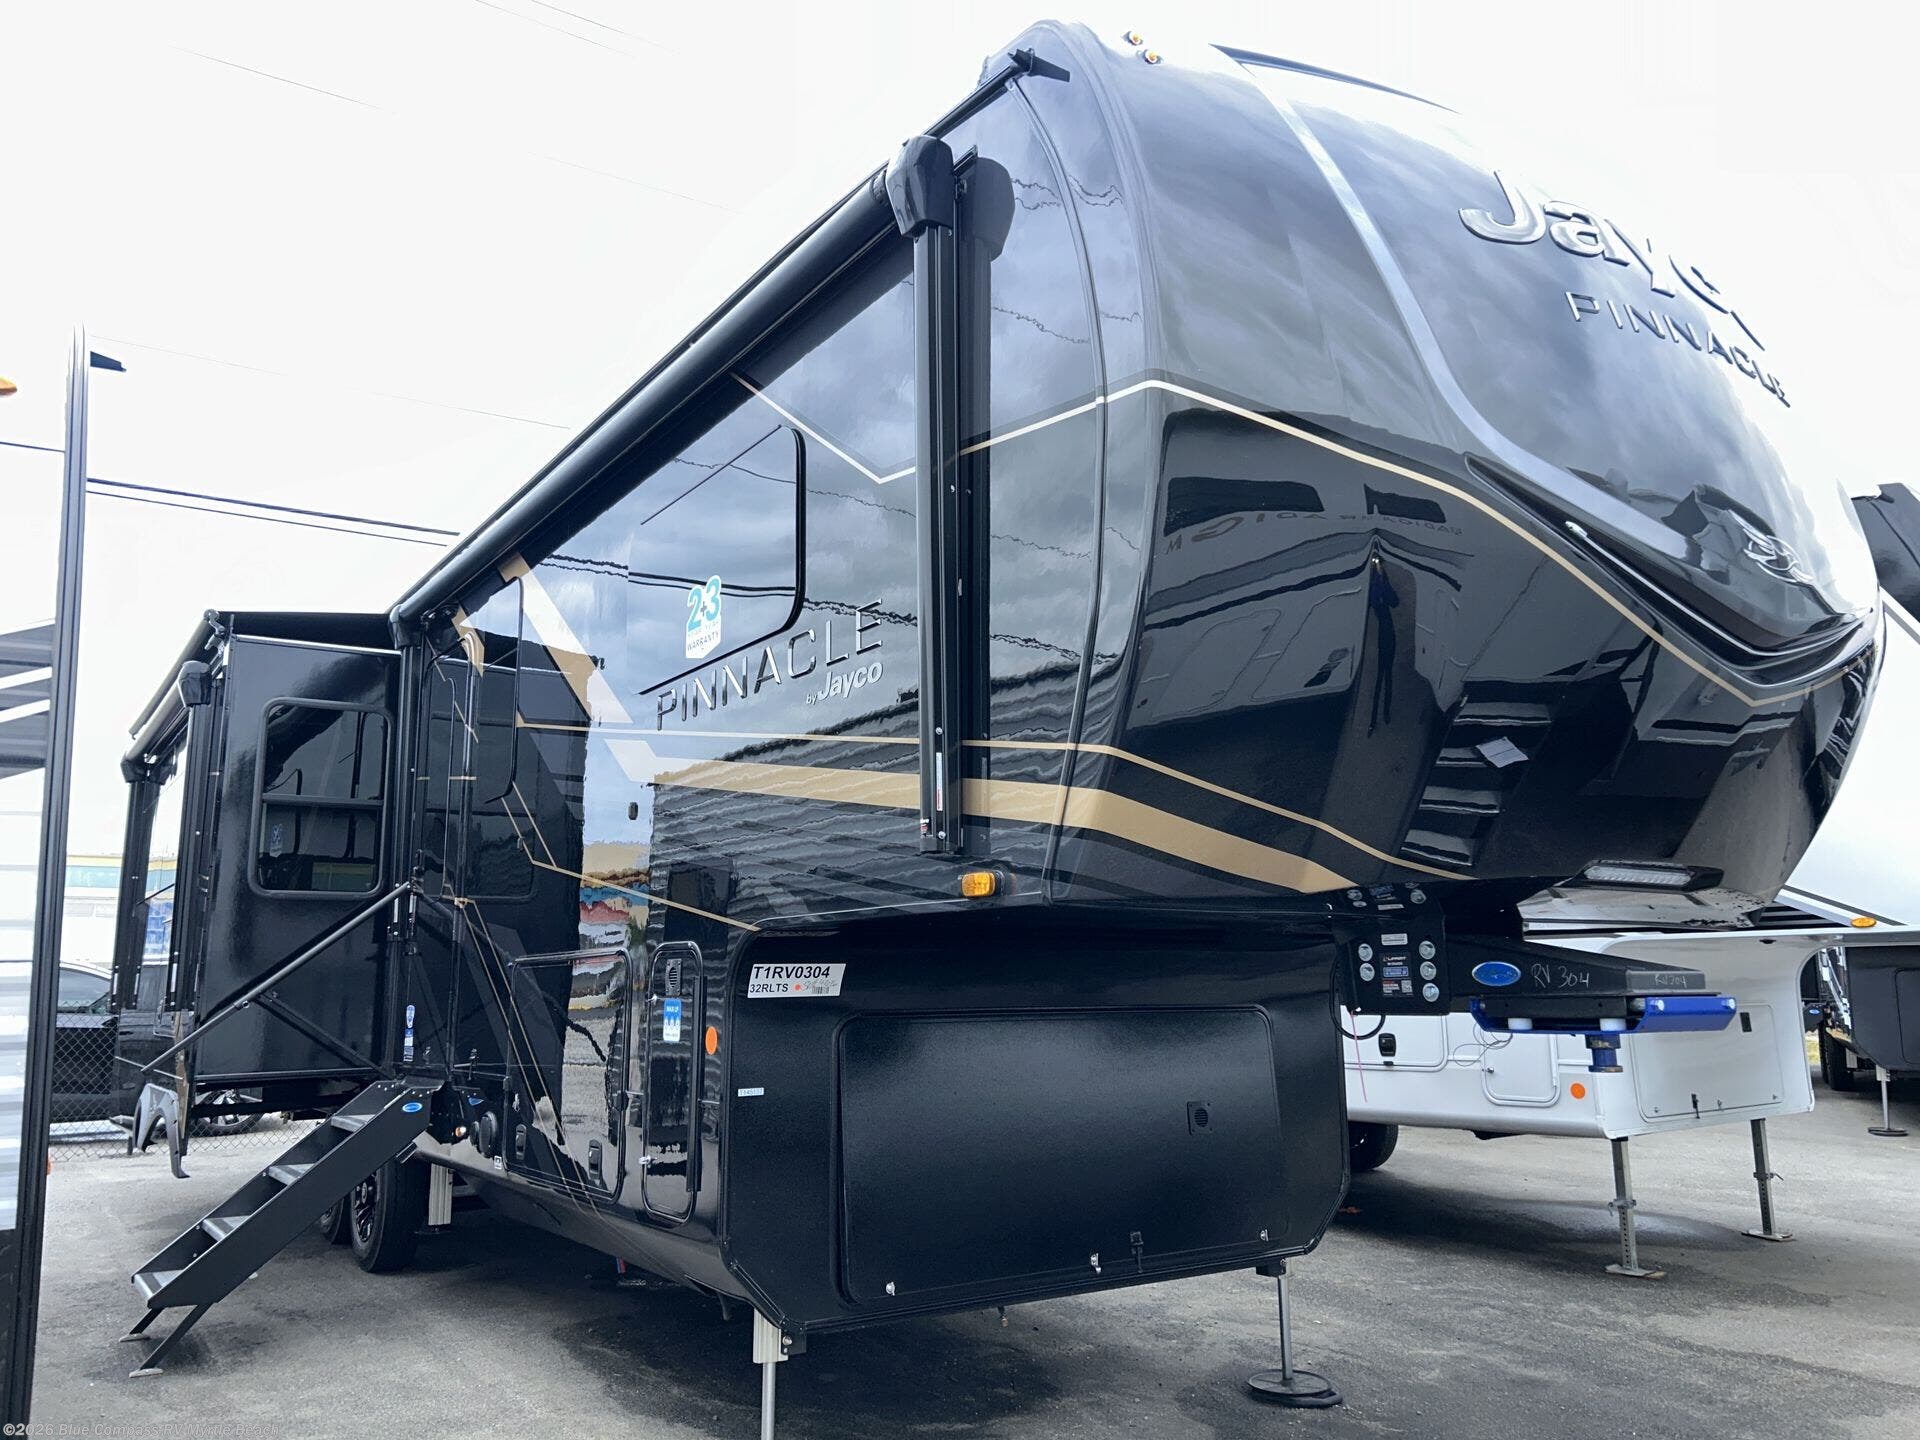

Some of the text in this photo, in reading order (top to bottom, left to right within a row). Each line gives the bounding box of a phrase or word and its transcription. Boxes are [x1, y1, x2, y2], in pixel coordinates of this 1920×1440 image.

[657, 596, 883, 731] PINNACLE
[806, 660, 884, 706] by Jayco
[754, 965, 831, 979] T1RV0304
[1531, 963, 1551, 987] RV
[1559, 966, 1591, 988] 304
[749, 983, 789, 993] 32RLTS
